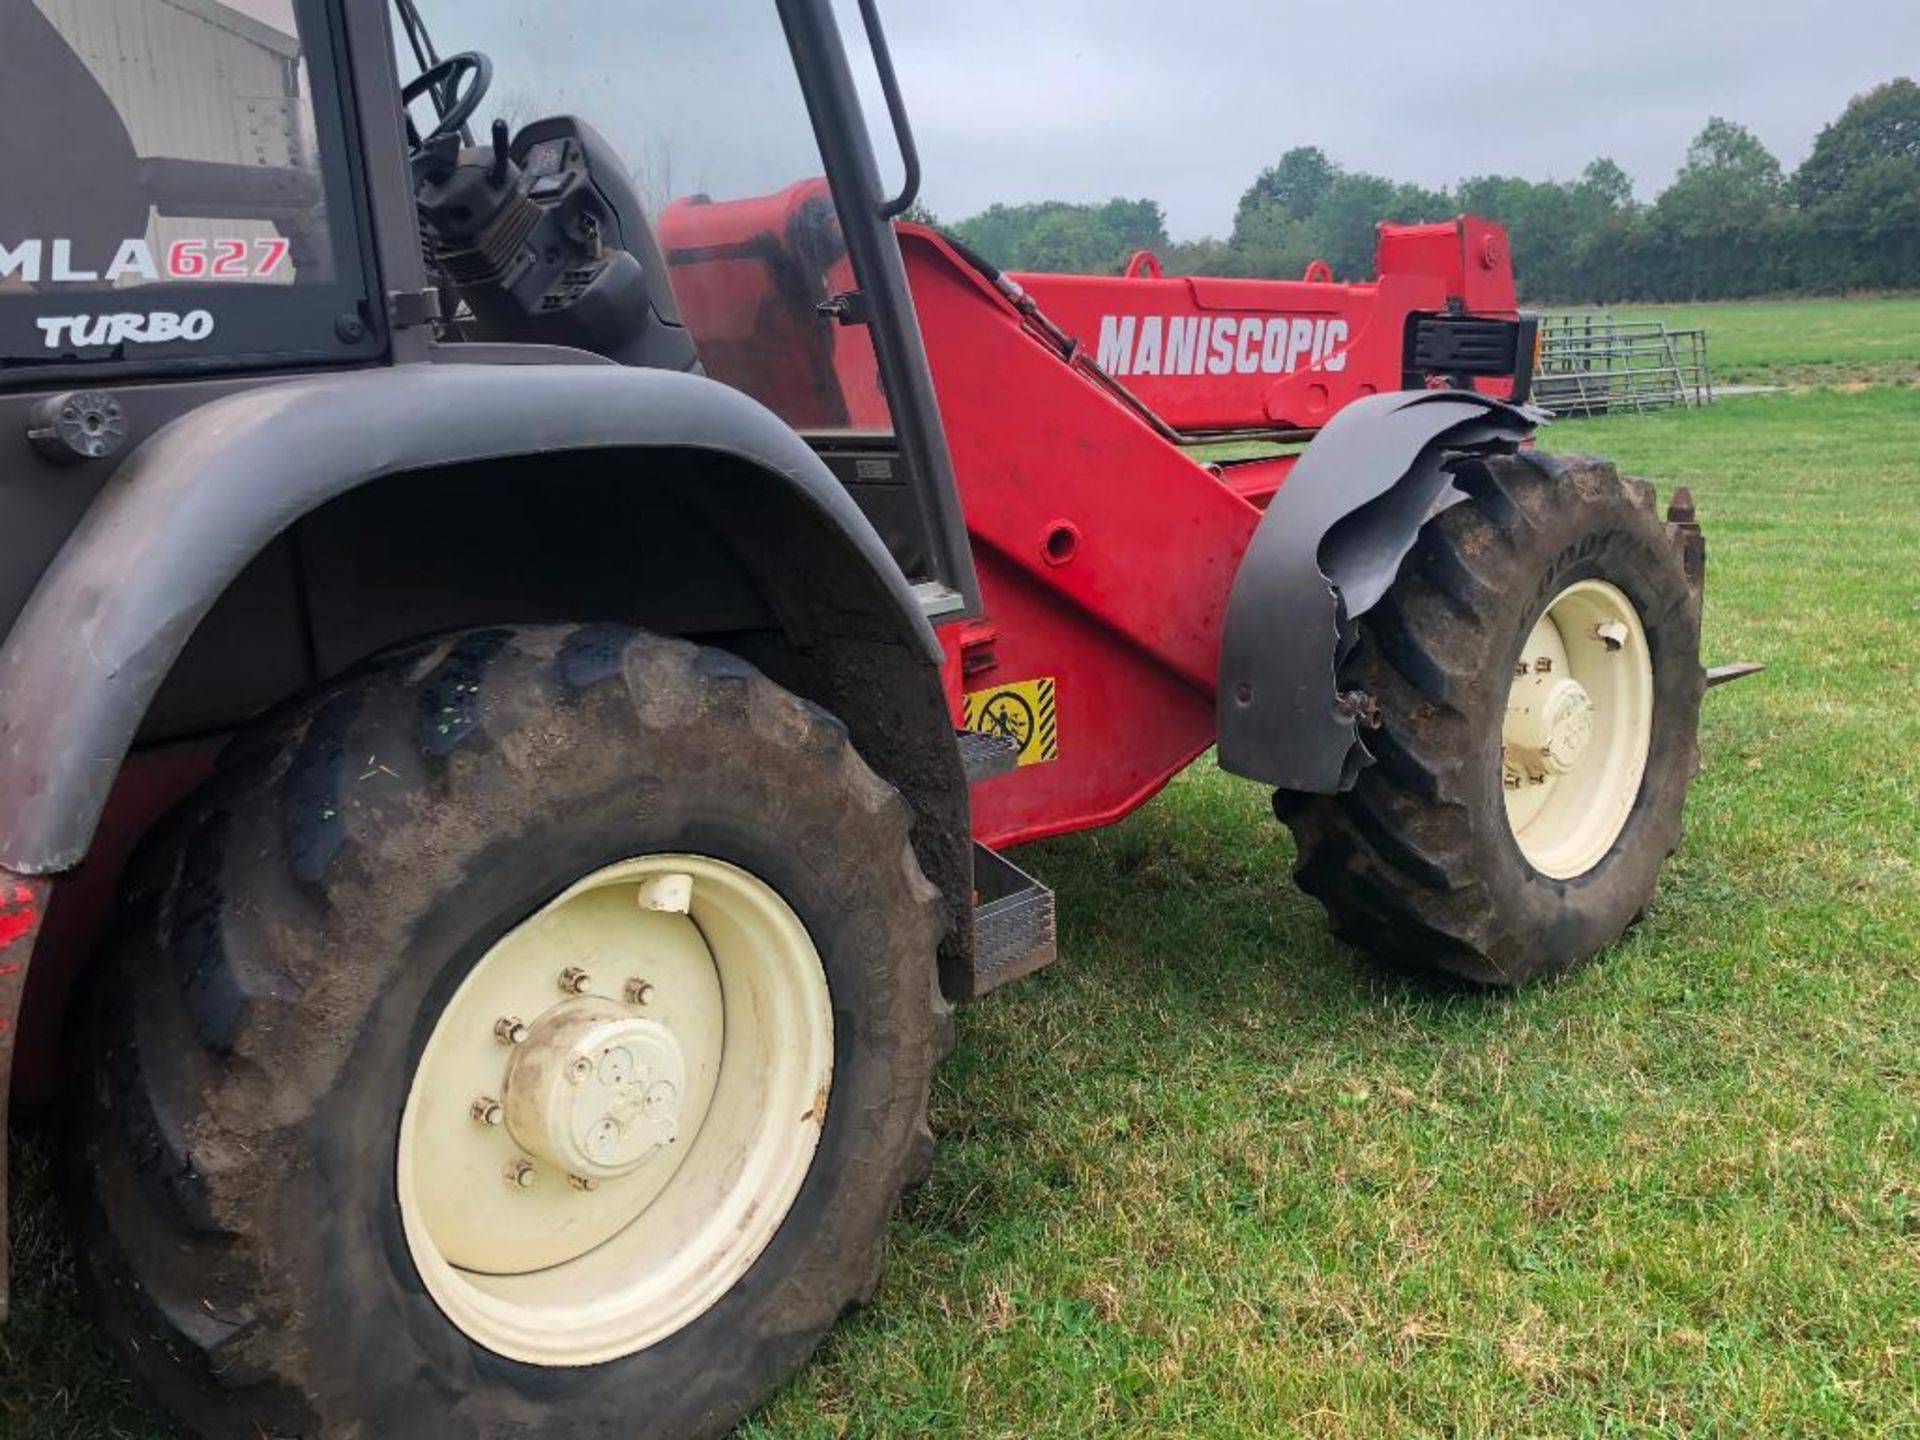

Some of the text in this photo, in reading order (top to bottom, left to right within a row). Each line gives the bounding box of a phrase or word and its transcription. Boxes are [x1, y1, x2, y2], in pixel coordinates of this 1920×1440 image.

[167, 238, 290, 279] 627
[37, 310, 214, 348] TURBO
[1097, 315, 1349, 376] MANISCOPIC
